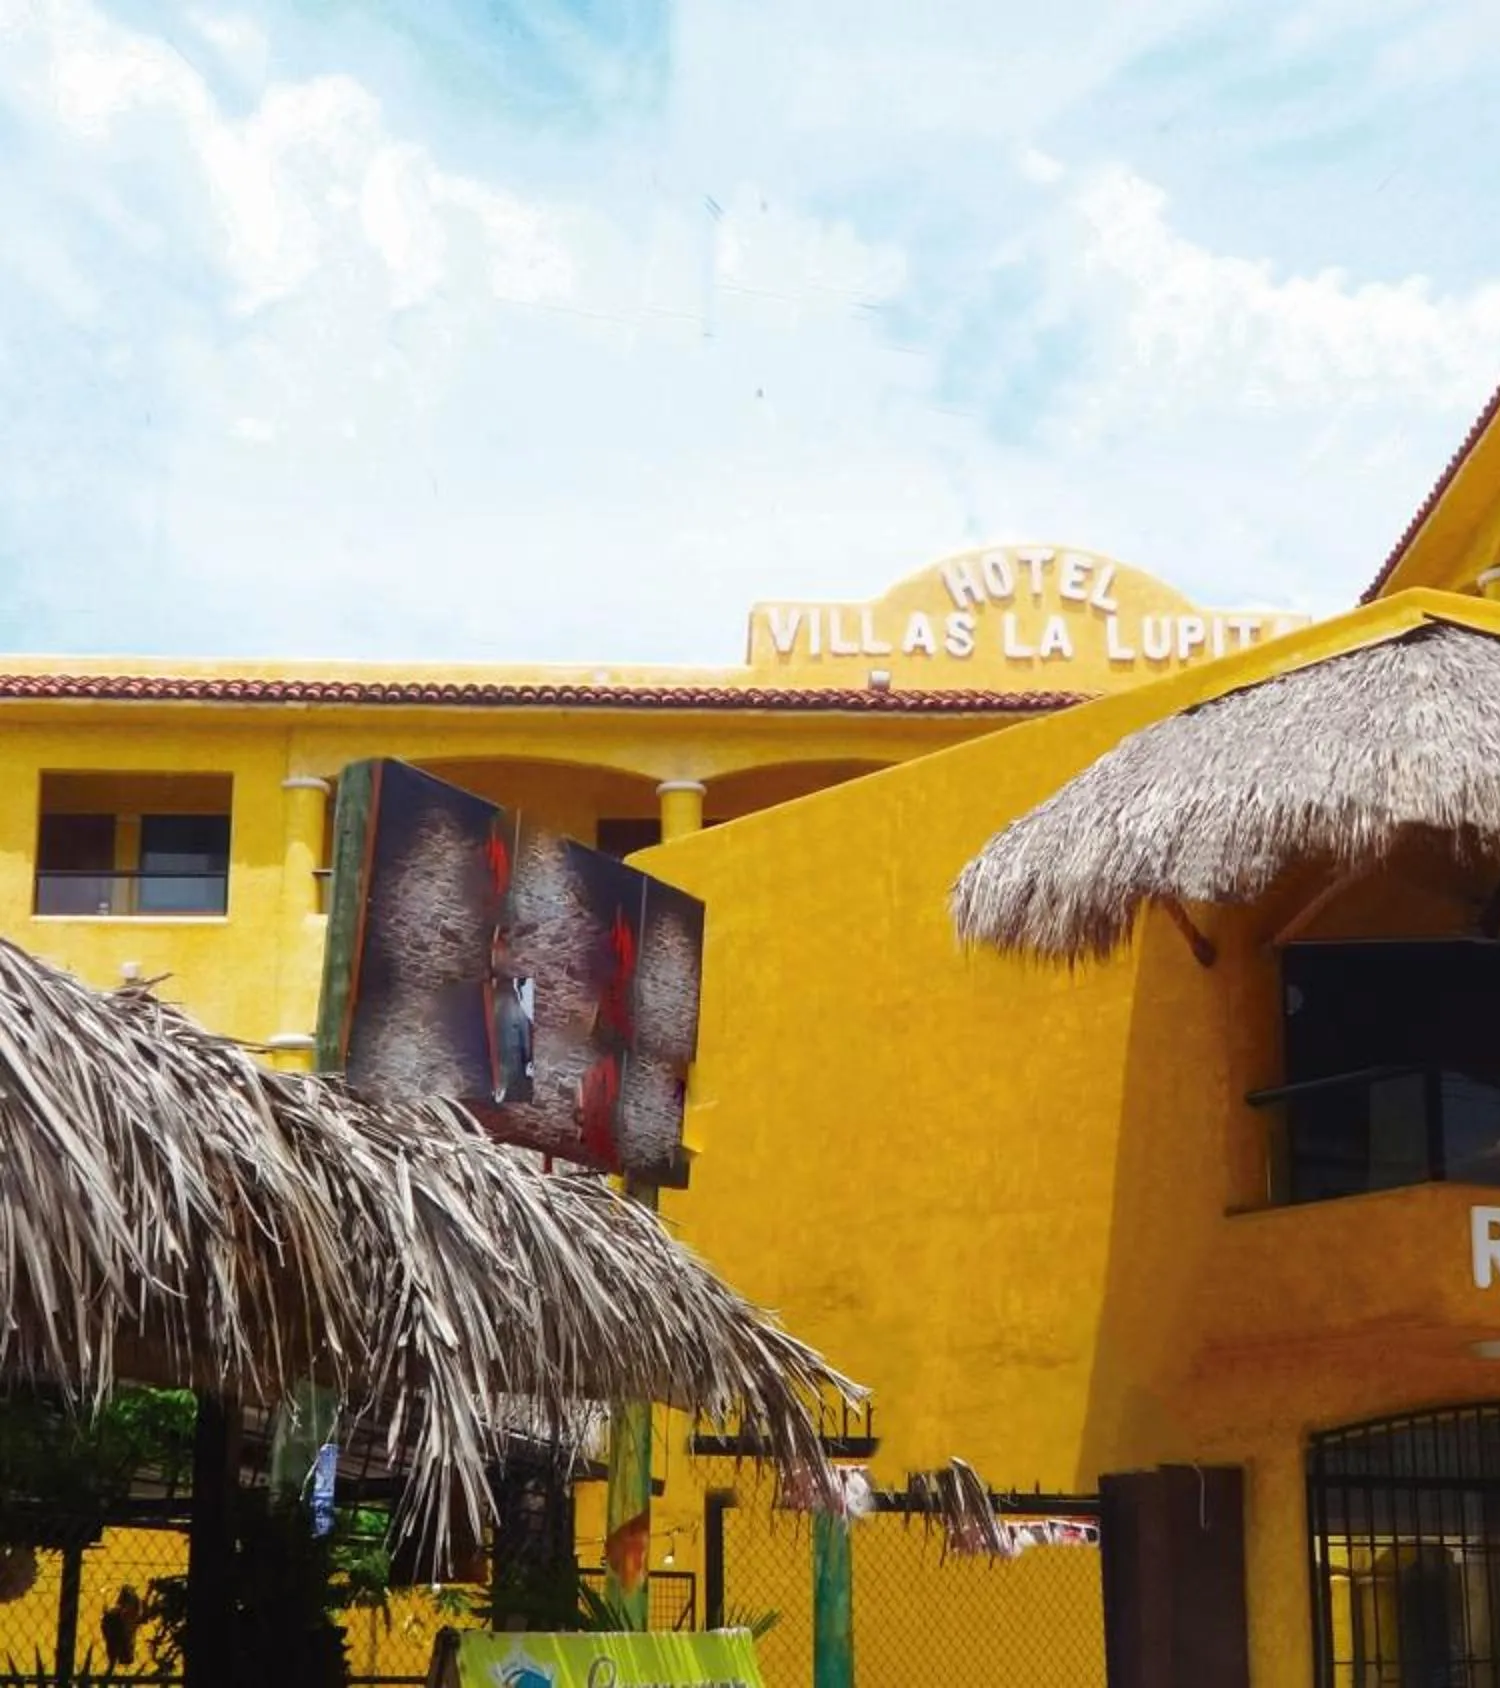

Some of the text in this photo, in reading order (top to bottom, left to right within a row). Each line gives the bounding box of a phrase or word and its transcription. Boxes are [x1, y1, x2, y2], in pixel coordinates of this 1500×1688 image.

[940, 548, 1119, 612] HOTEL
[767, 605, 976, 658] VILLAS
[1004, 613, 1074, 660] LA
